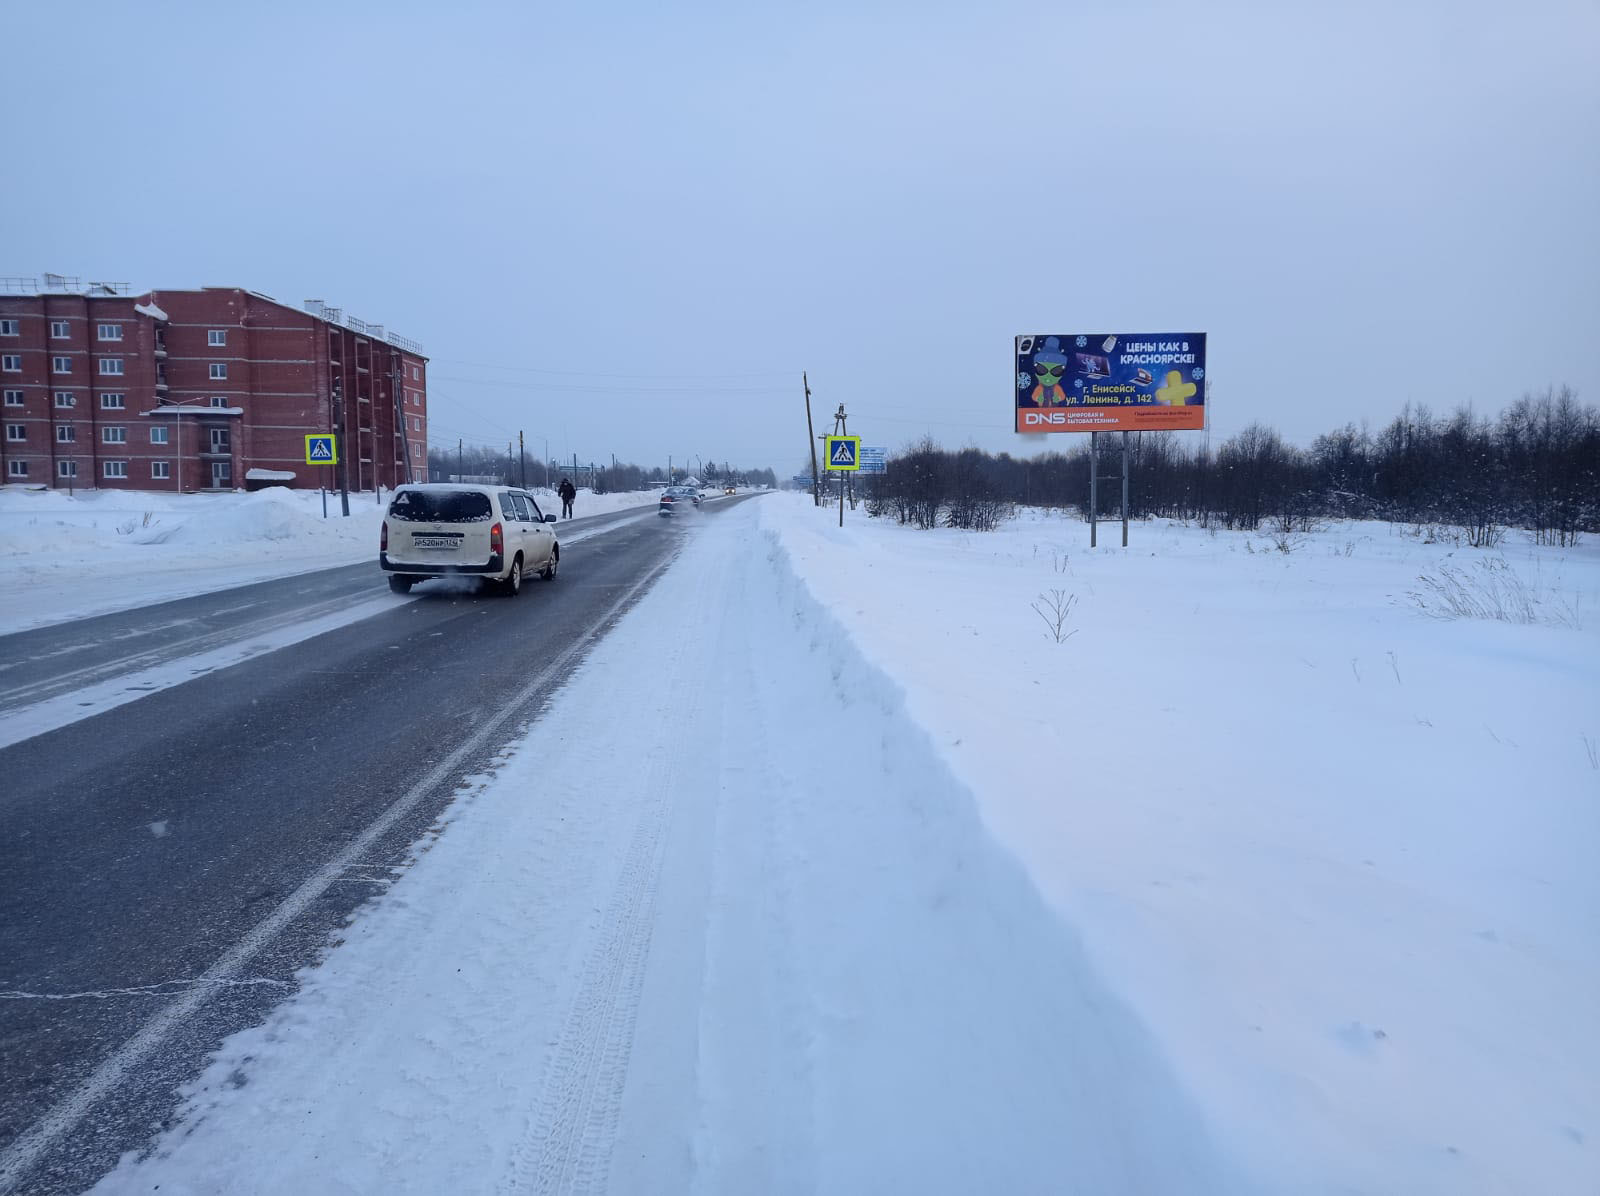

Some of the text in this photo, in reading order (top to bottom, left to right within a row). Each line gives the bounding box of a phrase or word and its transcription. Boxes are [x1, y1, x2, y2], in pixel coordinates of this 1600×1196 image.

[1126, 341, 1189, 354] ЦЕНЫ КАК В
[1120, 353, 1195, 365] КРАСНОЯРСКЕ!
[1082, 384, 1136, 394] г. Енисейск
[1065, 394, 1152, 406] ул. Ленина, д. 142
[1026, 412, 1066, 425] DNS
